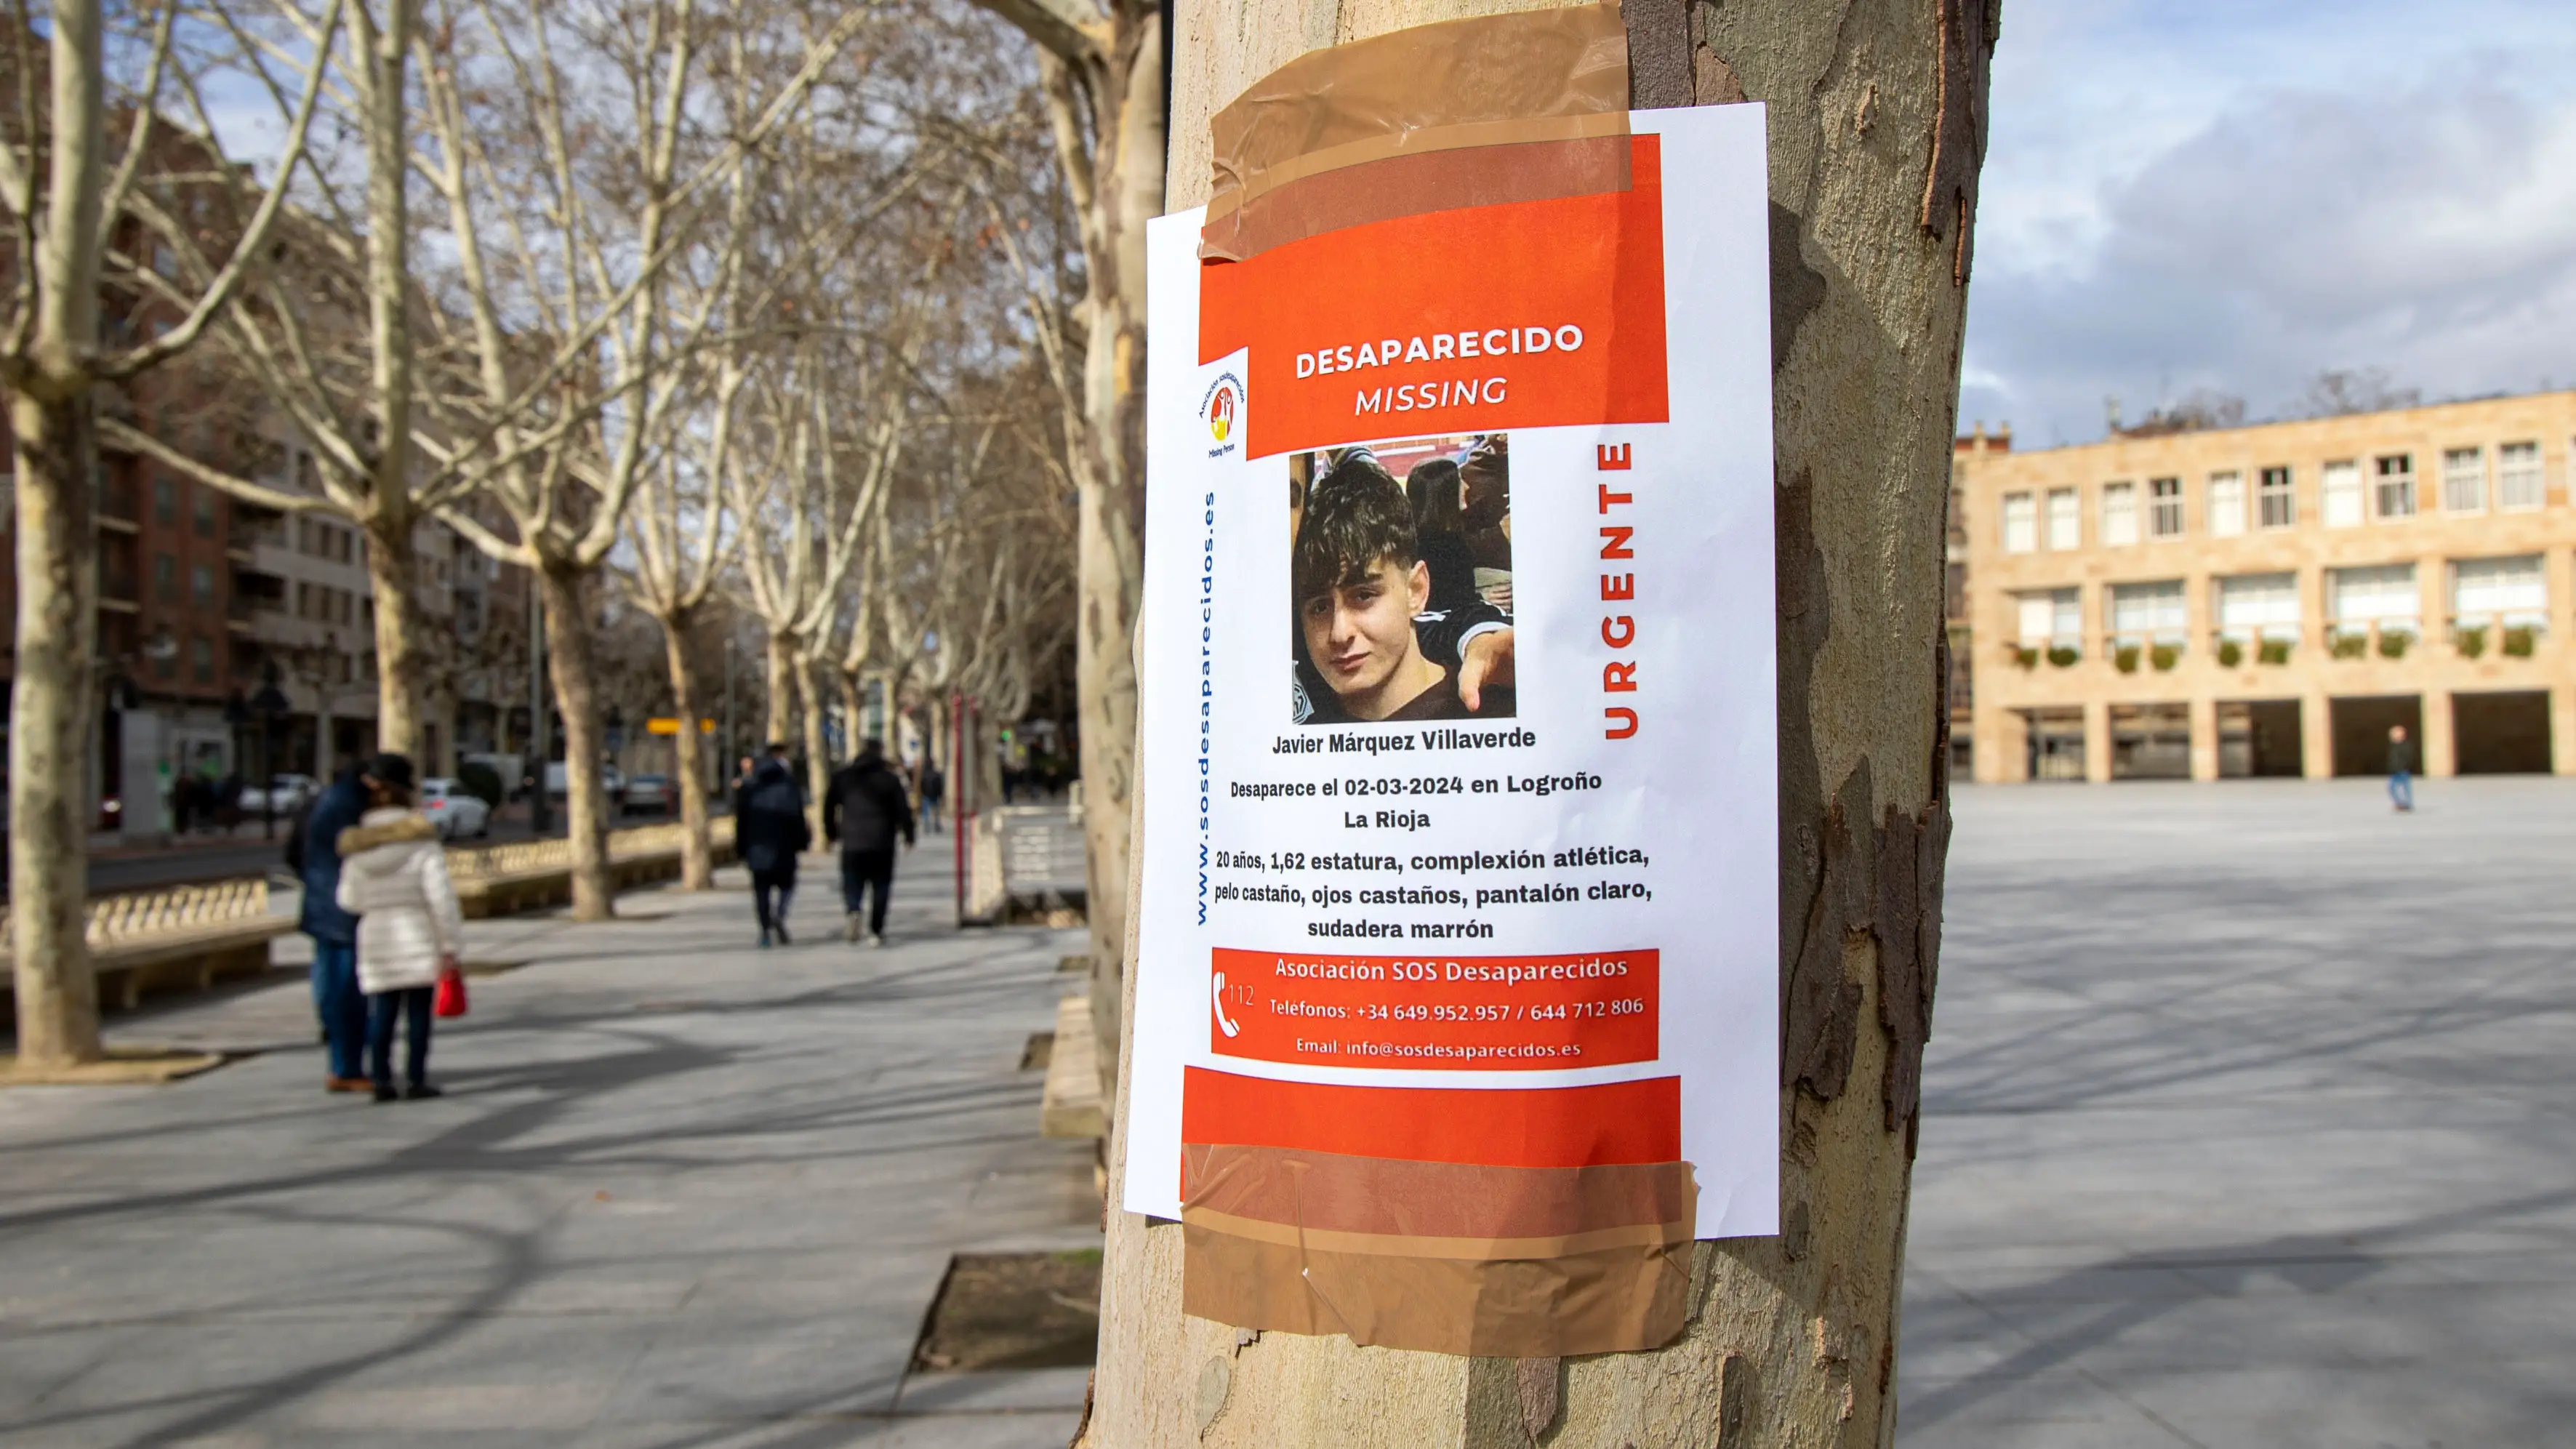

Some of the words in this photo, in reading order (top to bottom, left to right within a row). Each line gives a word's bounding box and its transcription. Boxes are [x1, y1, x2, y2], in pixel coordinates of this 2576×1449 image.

[1296, 324, 1584, 379] DESAPARECIDO
[1355, 377, 1507, 416] MISSING
[1208, 447, 1222, 458] Missing
[1223, 443, 1235, 454] Person
[1597, 443, 1638, 739] URGENTE
[1198, 492, 1214, 926] www.sosdesaparecidos.es
[1272, 734, 1324, 754] Javier
[1329, 731, 1415, 756] Márquez
[1421, 726, 1536, 750] Villaverde
[1231, 782, 1316, 801] Desaparece
[1322, 778, 1338, 796] el
[1345, 776, 1464, 795] 02-03-2024
[1471, 779, 1498, 793] en
[1507, 771, 1602, 796] Logroño
[1344, 811, 1368, 828] La
[1376, 809, 1431, 832] Rioja
[1216, 851, 1229, 867] 20
[1232, 851, 1265, 873] años,
[1271, 852, 1305, 874] 1,62
[1311, 852, 1403, 875] estatura,
[1411, 849, 1545, 875] complexión
[1554, 846, 1649, 868] atlética,
[1215, 882, 1239, 904] pelo
[1242, 884, 1305, 907] castaño,
[1312, 885, 1352, 909] ojos
[1359, 886, 1468, 909] castaños,
[1476, 883, 1580, 909] pantalón
[1587, 880, 1652, 902] claro,
[1308, 918, 1404, 938] sudadera
[1411, 919, 1493, 938] marrón
[1275, 958, 1384, 980] Asociación
[1392, 962, 1437, 981] SOS
[1445, 958, 1627, 986] Desaparecidos
[1229, 984, 1254, 1006] 112
[1270, 999, 1351, 1019] Teléfonos:
[1357, 1004, 1388, 1019] +34
[1394, 1005, 1509, 1021] 649.952.957
[1517, 1006, 1523, 1019] /
[1530, 1005, 1566, 1020] 644
[1572, 1002, 1605, 1017] 712
[1611, 999, 1643, 1014] 806
[1296, 1037, 1341, 1053] Email:
[1347, 1041, 1581, 1061] info@sosdesaparecidos.es
